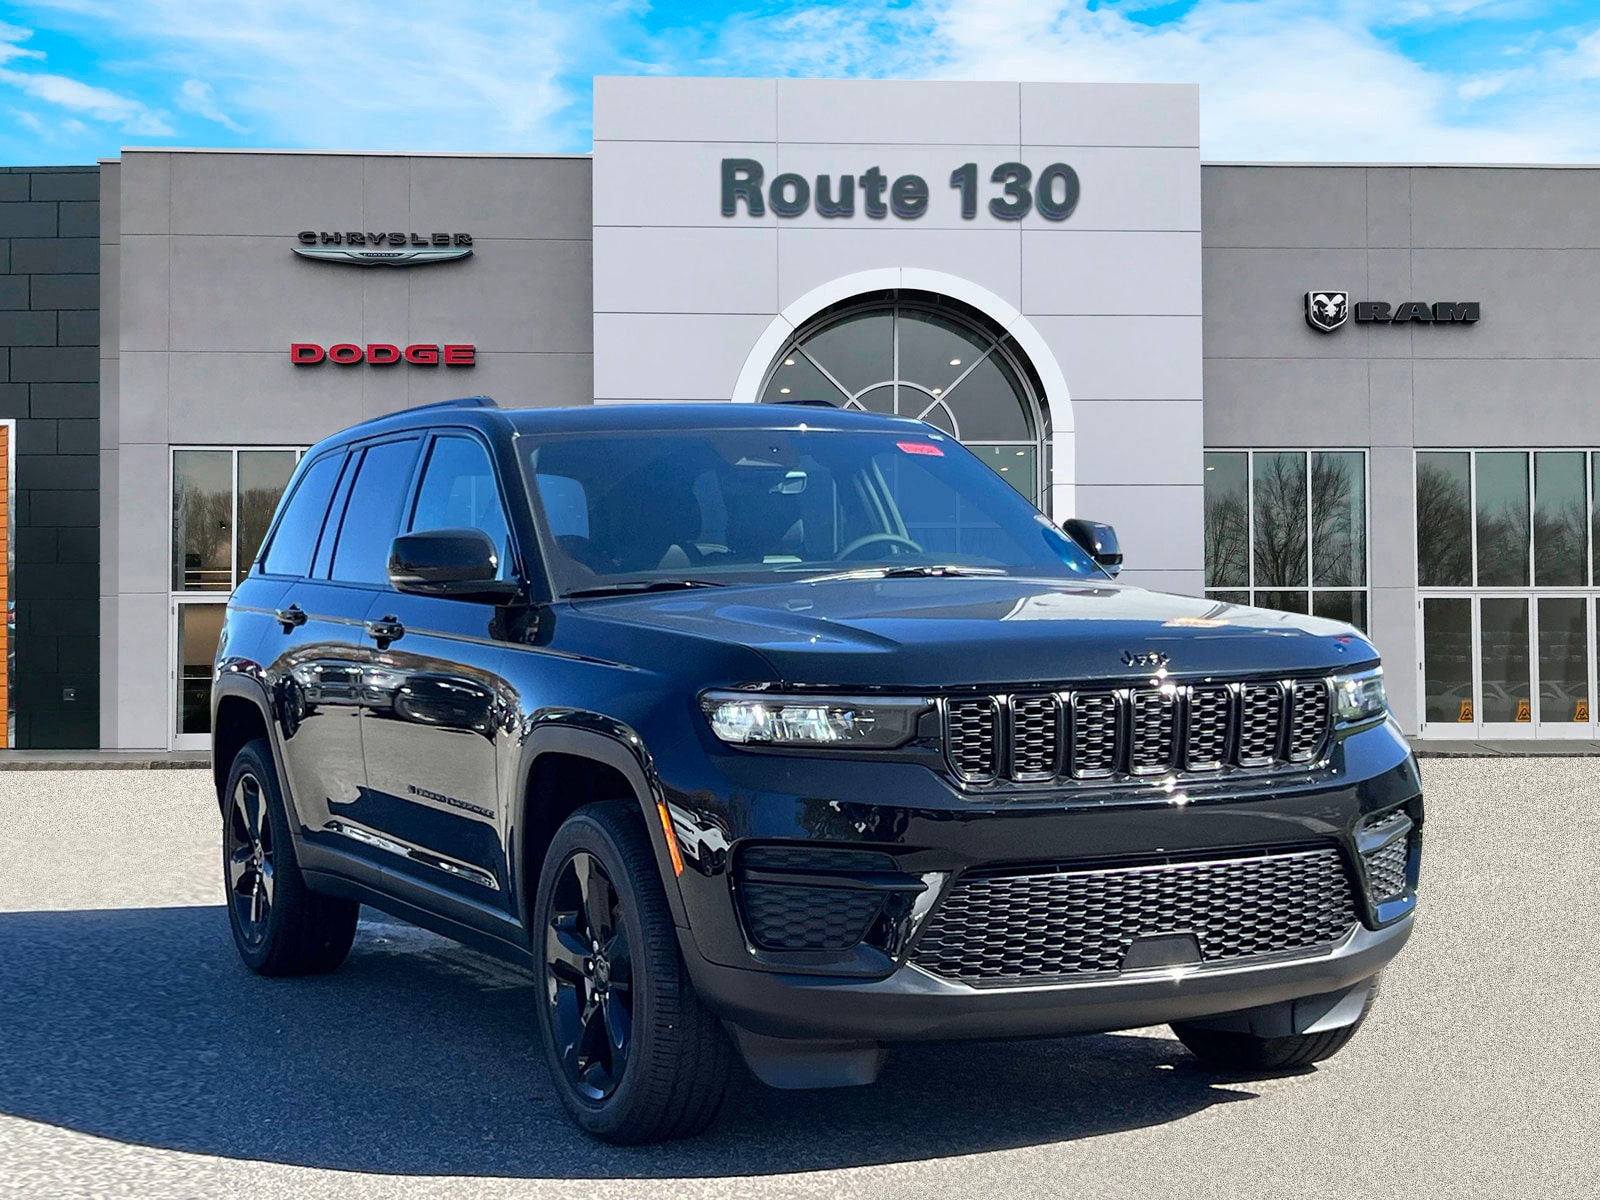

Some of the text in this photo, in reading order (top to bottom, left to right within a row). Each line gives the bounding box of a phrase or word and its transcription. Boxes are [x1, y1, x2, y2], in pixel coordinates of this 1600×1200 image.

[720, 158, 1080, 221] Route 130
[298, 231, 473, 246] CHRYSLER
[1354, 301, 1480, 324] RAM
[290, 343, 476, 366] DODGE
